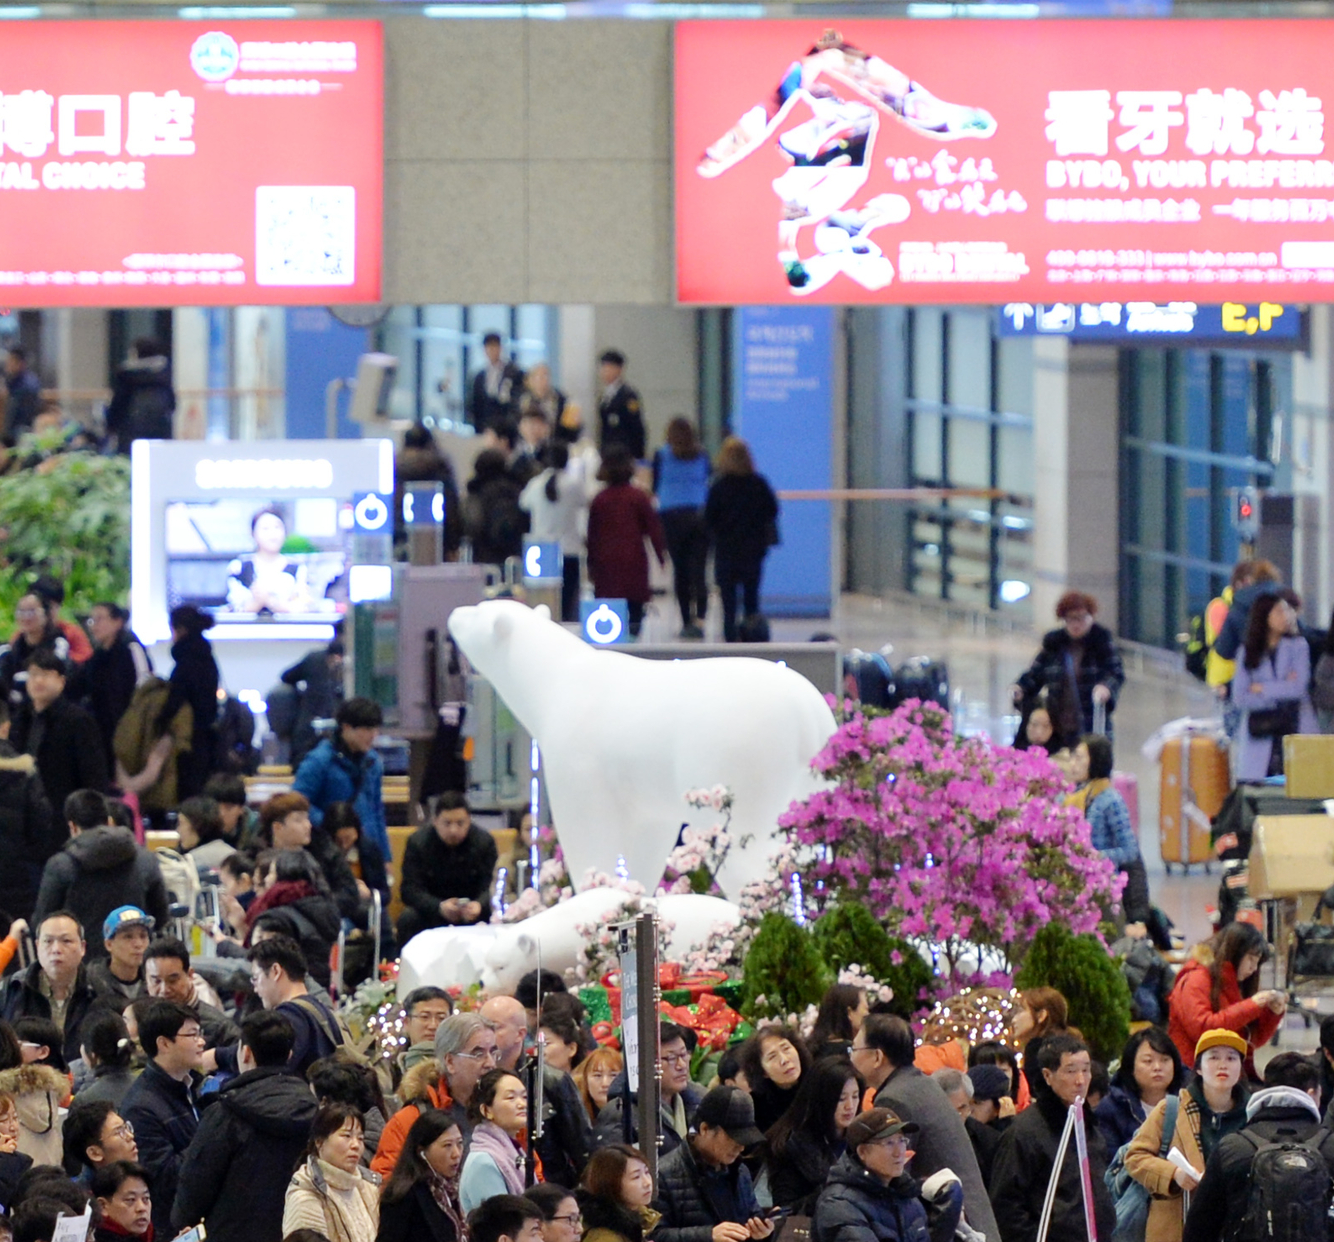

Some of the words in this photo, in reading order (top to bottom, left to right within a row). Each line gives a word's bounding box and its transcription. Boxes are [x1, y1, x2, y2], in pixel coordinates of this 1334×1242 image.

[1044, 88, 1325, 156] 看牙就选
[43, 162, 146, 189] CHOICE
[1133, 160, 1207, 187] YOUR
